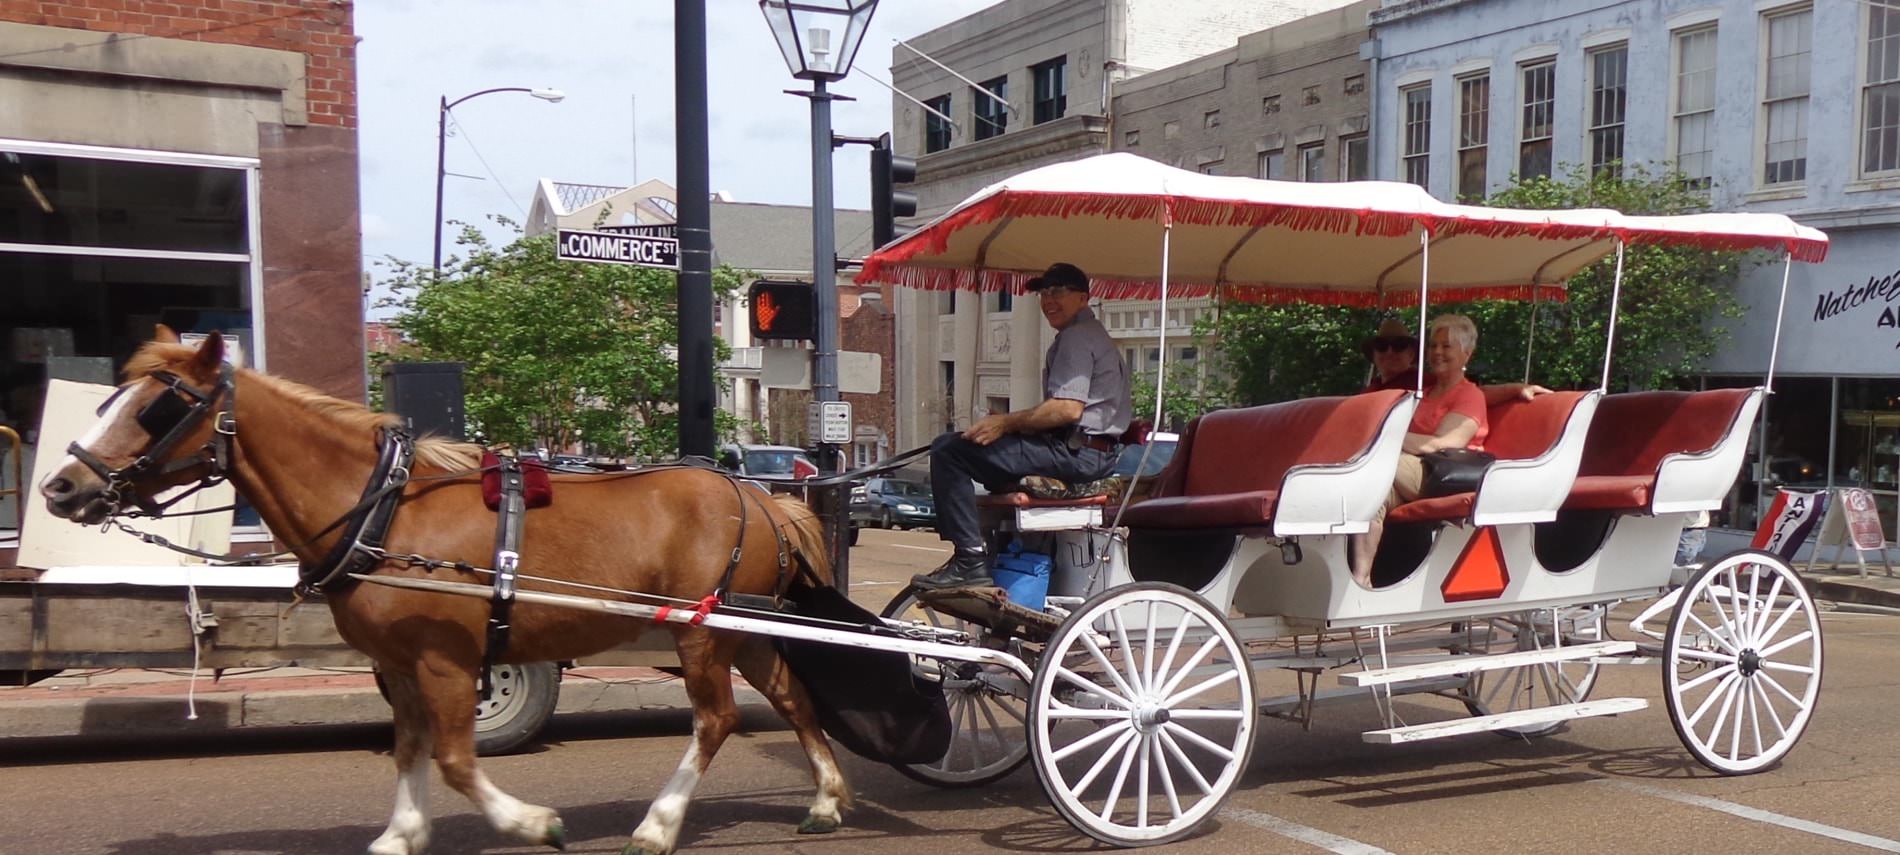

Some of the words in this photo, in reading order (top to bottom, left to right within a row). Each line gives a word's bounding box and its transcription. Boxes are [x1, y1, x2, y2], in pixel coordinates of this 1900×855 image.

[561, 243, 568, 255] N
[568, 234, 664, 263] COMMERCE
[663, 243, 675, 254] ST
[1877, 306, 1900, 328] A
